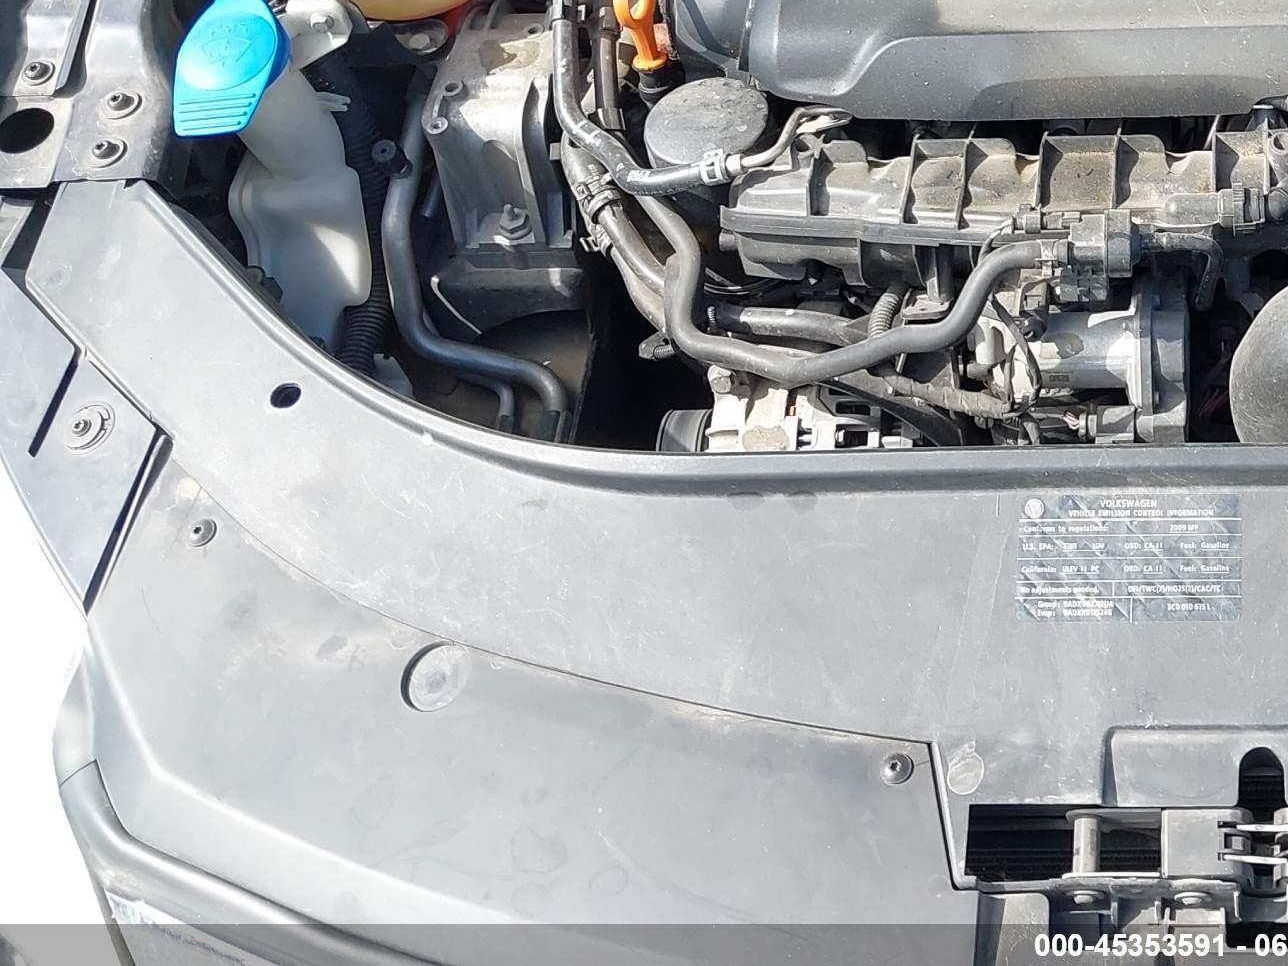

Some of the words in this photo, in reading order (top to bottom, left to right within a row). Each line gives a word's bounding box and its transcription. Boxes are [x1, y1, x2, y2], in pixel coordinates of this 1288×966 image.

[1099, 498, 1158, 509] VOLKSWAGEN
[1068, 509, 1096, 517] VEHICLE
[1133, 509, 1164, 517] CONTROL
[1166, 509, 1214, 517] INFORMATION
[1200, 541, 1230, 549] Gasoline
[1200, 564, 1230, 572] Gasoline
